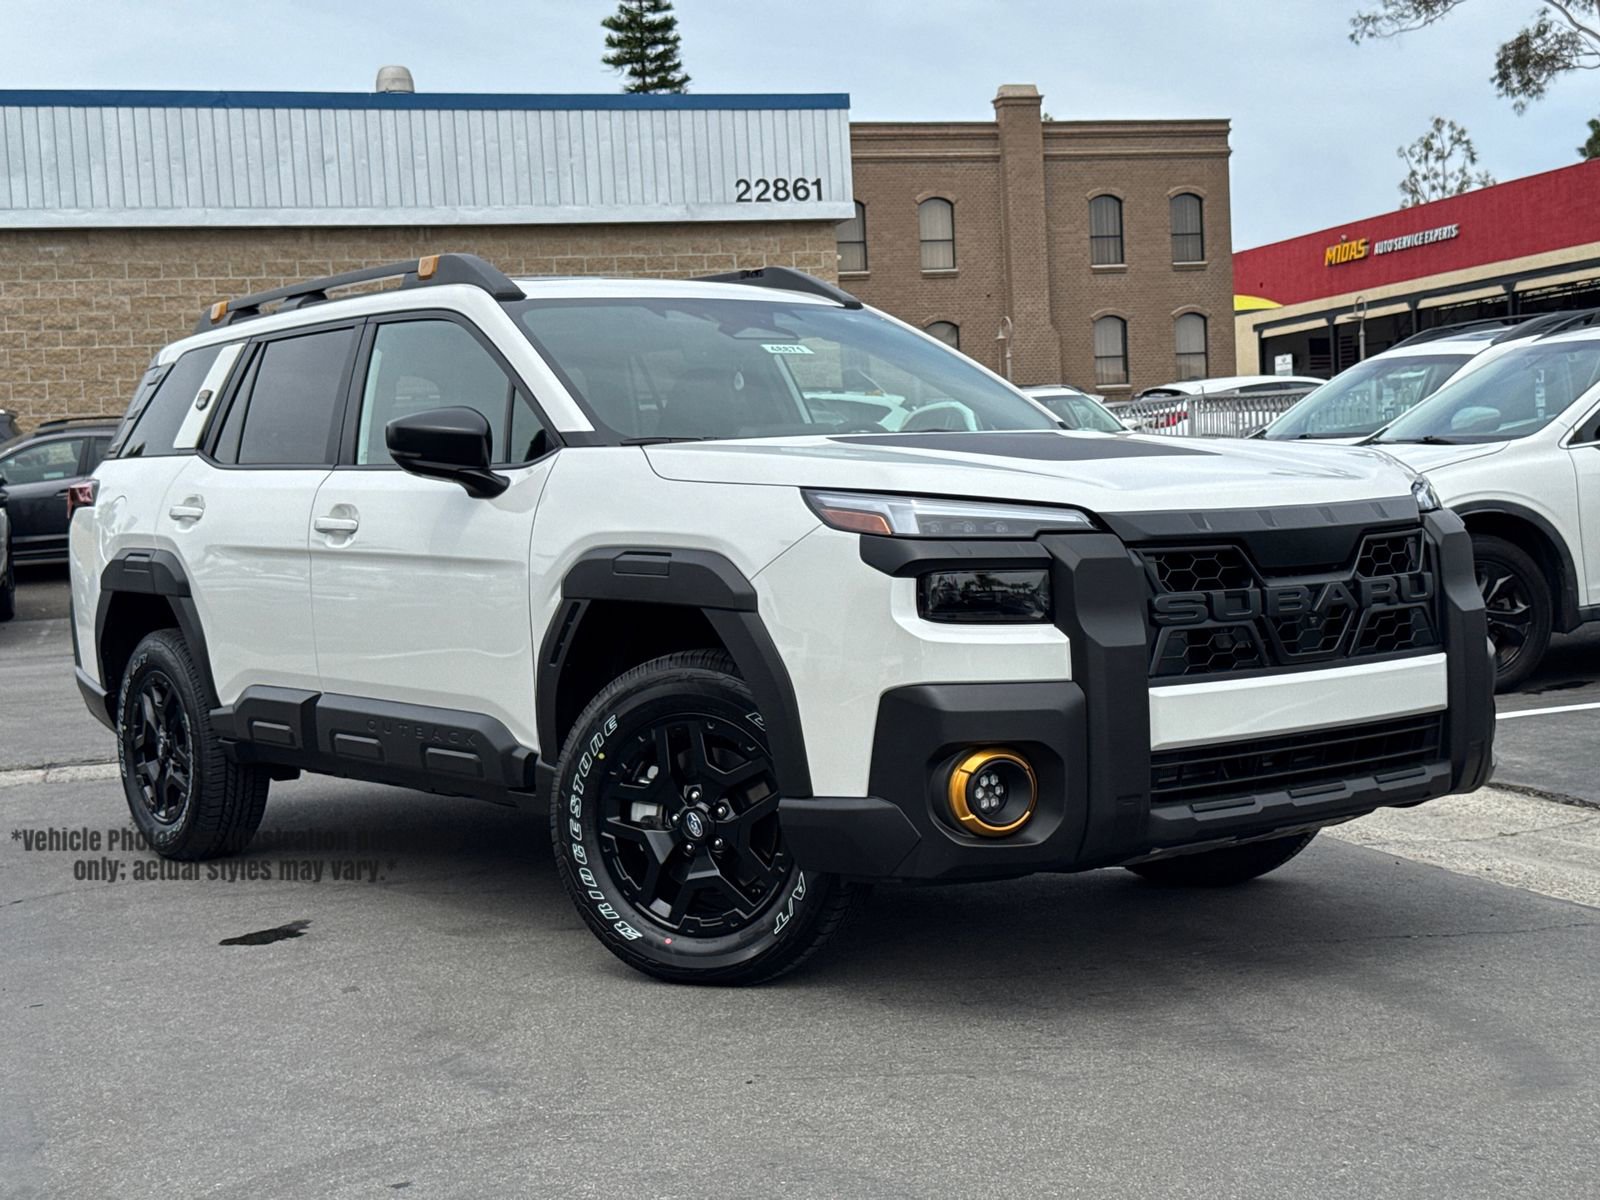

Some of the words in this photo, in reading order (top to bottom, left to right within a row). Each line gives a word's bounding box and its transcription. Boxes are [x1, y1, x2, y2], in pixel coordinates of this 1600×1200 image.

[735, 177, 823, 203] 22861
[1324, 238, 1369, 267] MIDAS
[1374, 238, 1394, 256] AUTO
[1394, 232, 1424, 251] SERVICE
[1424, 223, 1460, 244] EXPERTS
[1153, 571, 1433, 625] SUBARU
[366, 719, 477, 747] OUTBACK
[569, 714, 643, 941] BRIDGESTONE
[773, 871, 807, 935] A/T
